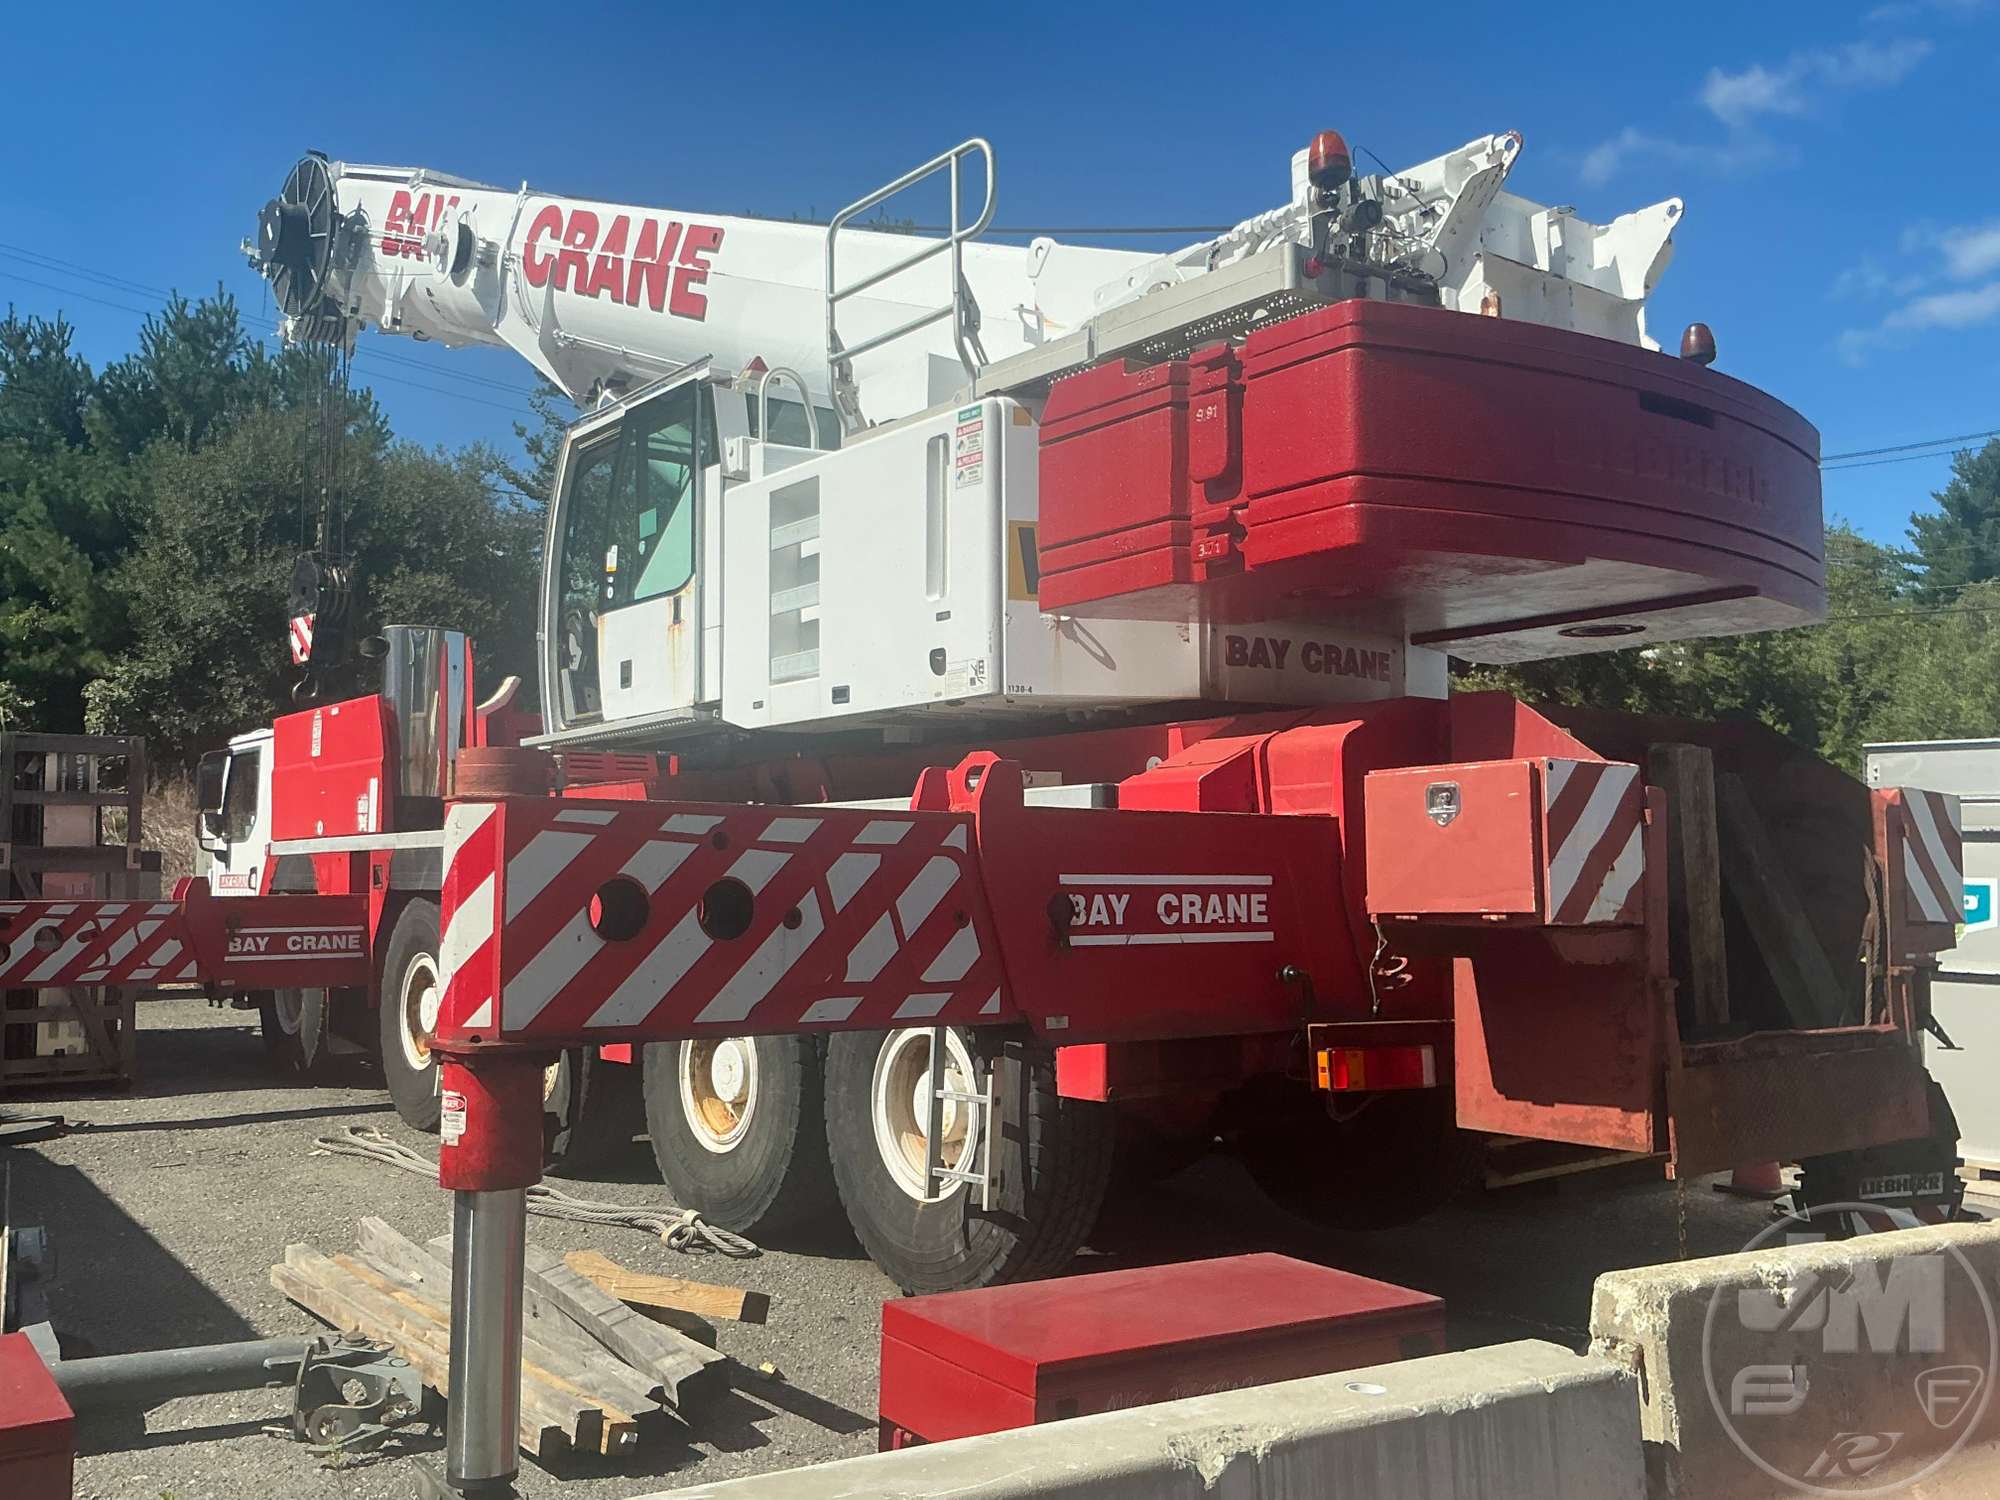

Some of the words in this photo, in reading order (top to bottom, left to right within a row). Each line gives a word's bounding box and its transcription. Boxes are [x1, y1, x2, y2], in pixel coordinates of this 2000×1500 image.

[523, 204, 725, 321] CRANE
[1225, 636, 1291, 669] BAY
[1302, 642, 1391, 681] CRANE
[1070, 894, 1129, 926] BAY
[1157, 893, 1268, 925] CRANE
[228, 936, 270, 953] BAY
[287, 933, 361, 952] CRANE
